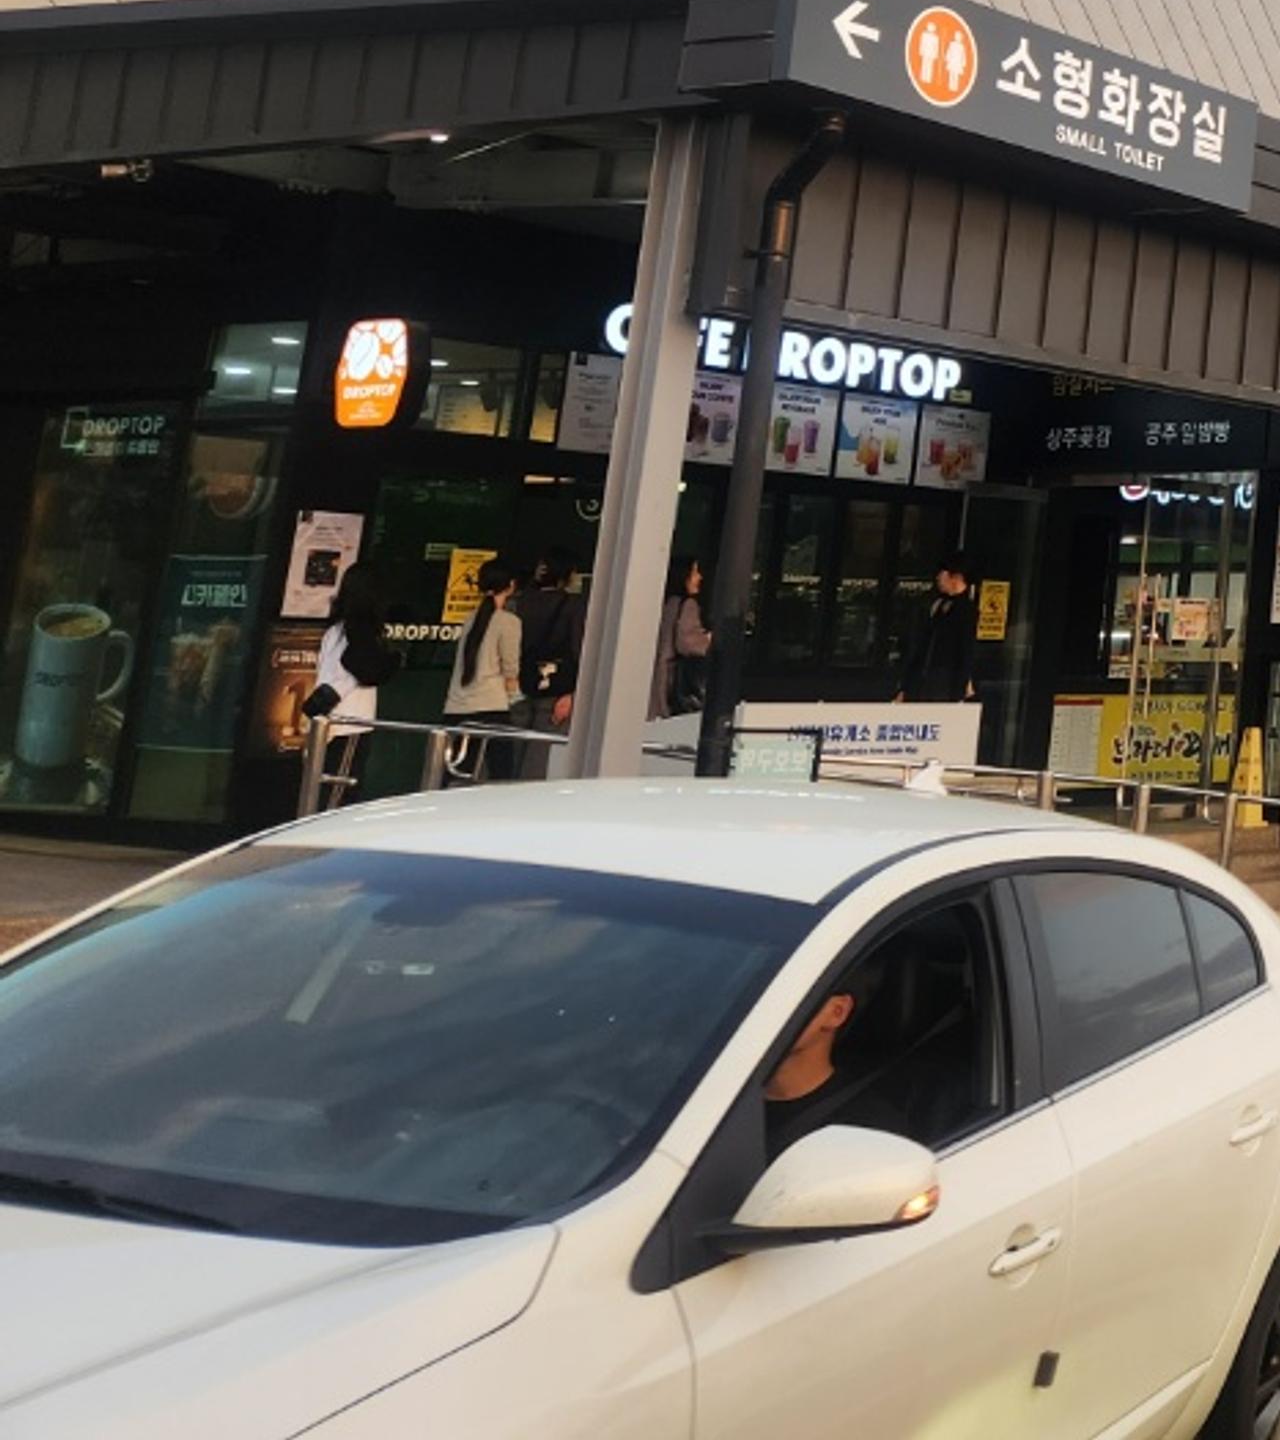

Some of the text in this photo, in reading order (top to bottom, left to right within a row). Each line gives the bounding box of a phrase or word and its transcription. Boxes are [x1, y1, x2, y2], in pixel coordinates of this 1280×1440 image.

[996, 37, 1228, 164] 소형화장실
[1055, 125, 1165, 172] SMALL TOILET
[743, 326, 962, 401] ROPTOP
[83, 415, 165, 437] DROPTOP
